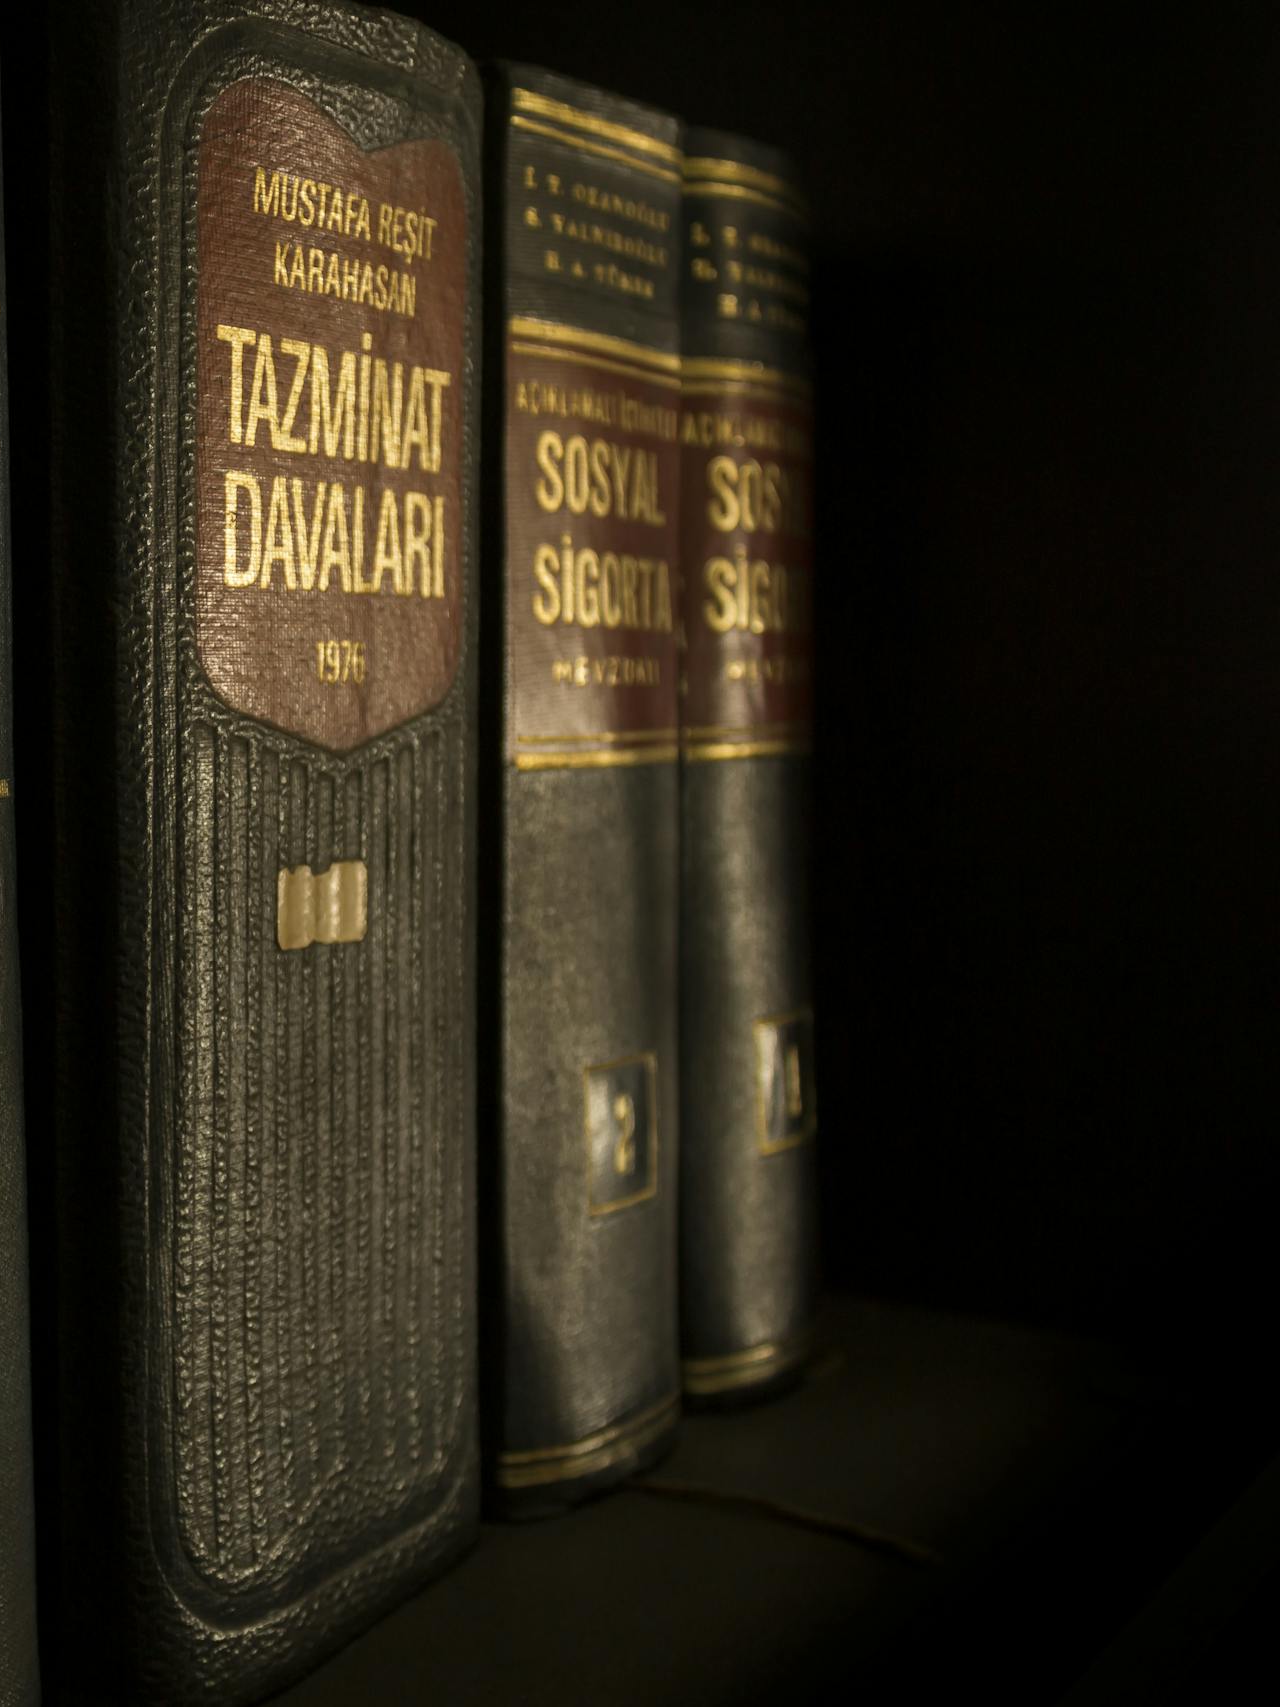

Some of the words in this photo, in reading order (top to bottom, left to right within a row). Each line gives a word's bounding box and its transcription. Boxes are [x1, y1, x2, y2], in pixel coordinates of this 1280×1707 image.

[252, 165, 372, 243] MUSTAFA
[377, 203, 438, 267] REŞİT
[273, 240, 418, 317] KARAHASAN
[216, 324, 451, 474] TAZMİNAT
[535, 430, 666, 527] SOSYAL
[223, 470, 447, 599] DAVALARI
[532, 533, 673, 633] SİGORTA
[315, 639, 366, 685] 1976
